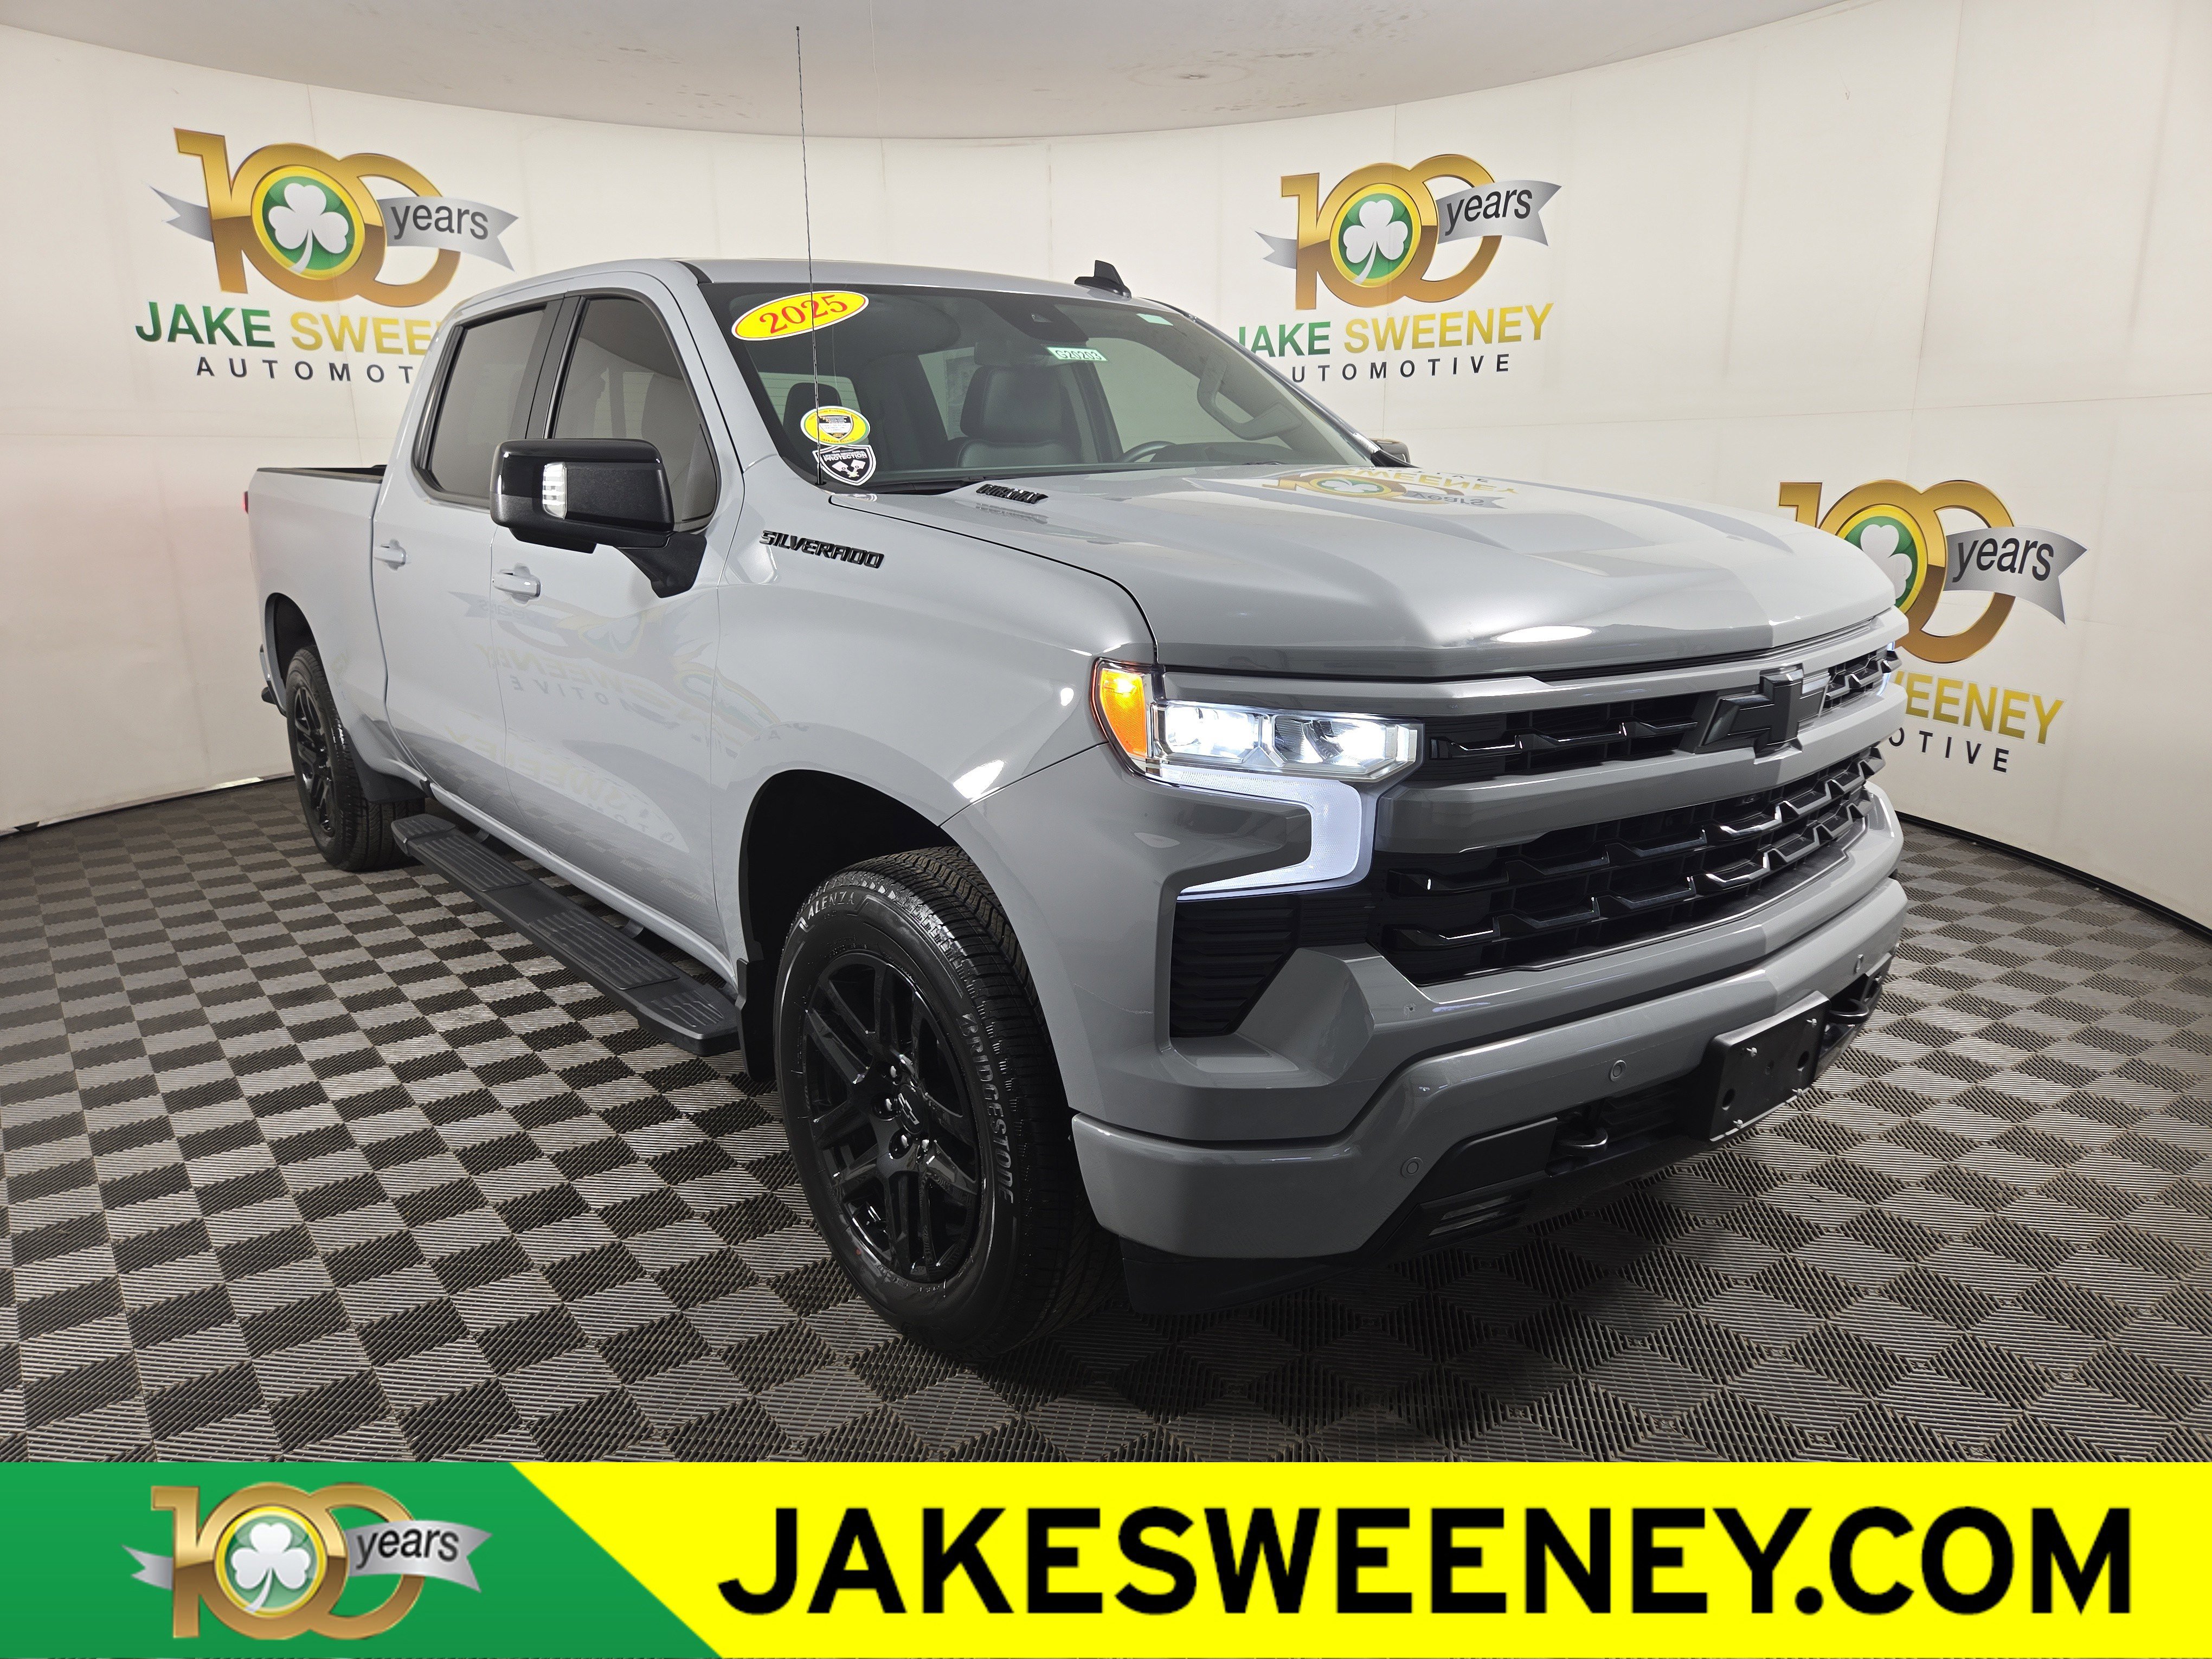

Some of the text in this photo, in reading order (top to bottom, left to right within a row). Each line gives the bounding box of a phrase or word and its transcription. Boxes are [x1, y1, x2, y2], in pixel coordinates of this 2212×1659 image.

[390, 204, 489, 241] years
[1444, 188, 1532, 237] years
[135, 301, 442, 356] JAKE SWEE
[760, 294, 847, 334] 2025
[1344, 303, 1554, 354] SWEENEY
[197, 356, 414, 384] AUTOMOT
[1055, 350, 1102, 359] G20203
[1292, 353, 1509, 383] UTOMOTIVE
[760, 530, 885, 569] SILVERADO
[1952, 538, 2054, 583] years
[1894, 671, 2065, 745] EENEY
[1889, 727, 2009, 773] OTIVE
[808, 891, 854, 920] ALENZA
[956, 1013, 1014, 1204] BRIDGESTONE
